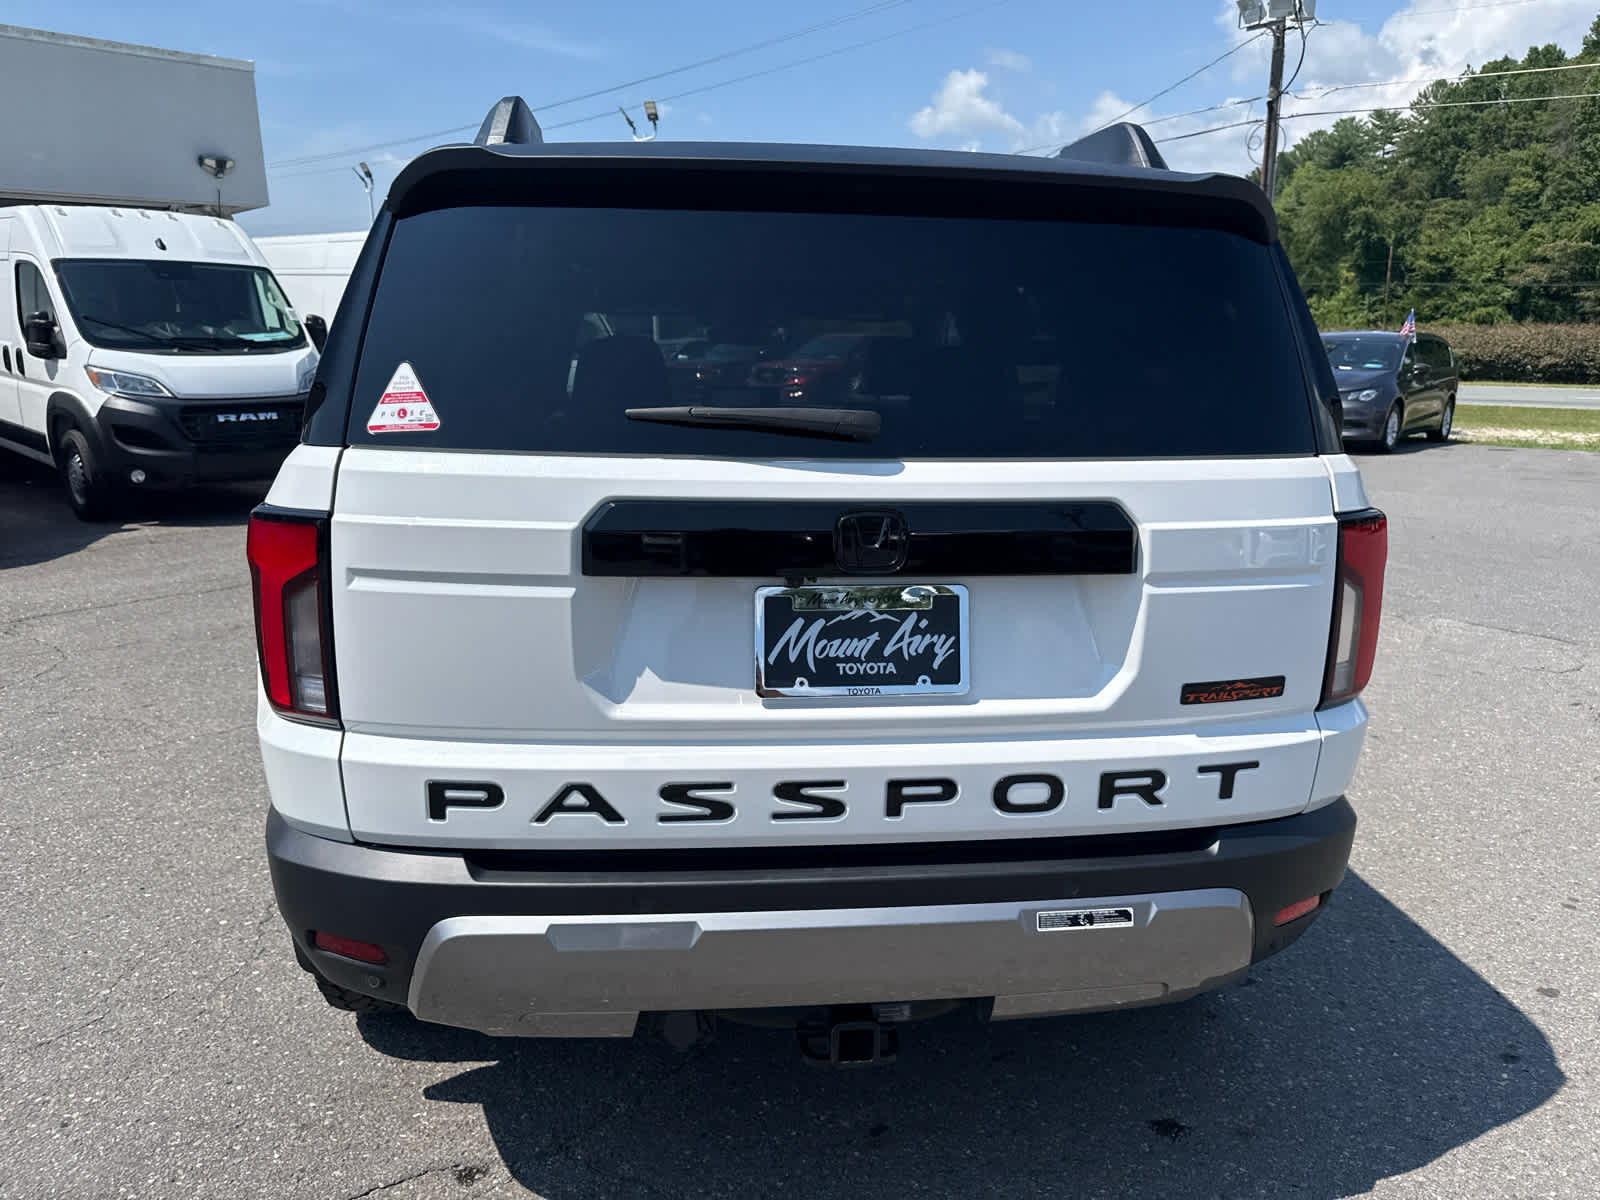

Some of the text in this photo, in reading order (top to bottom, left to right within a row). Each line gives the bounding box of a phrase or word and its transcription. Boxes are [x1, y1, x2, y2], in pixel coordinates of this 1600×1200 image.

[216, 412, 279, 423] RAM
[767, 611, 956, 673] Mount Airy
[836, 662, 897, 676] TOYOTA
[847, 687, 881, 696] TOYOTA
[1185, 686, 1281, 703] TRAILSPORT
[426, 760, 1260, 825] PASSPORT
